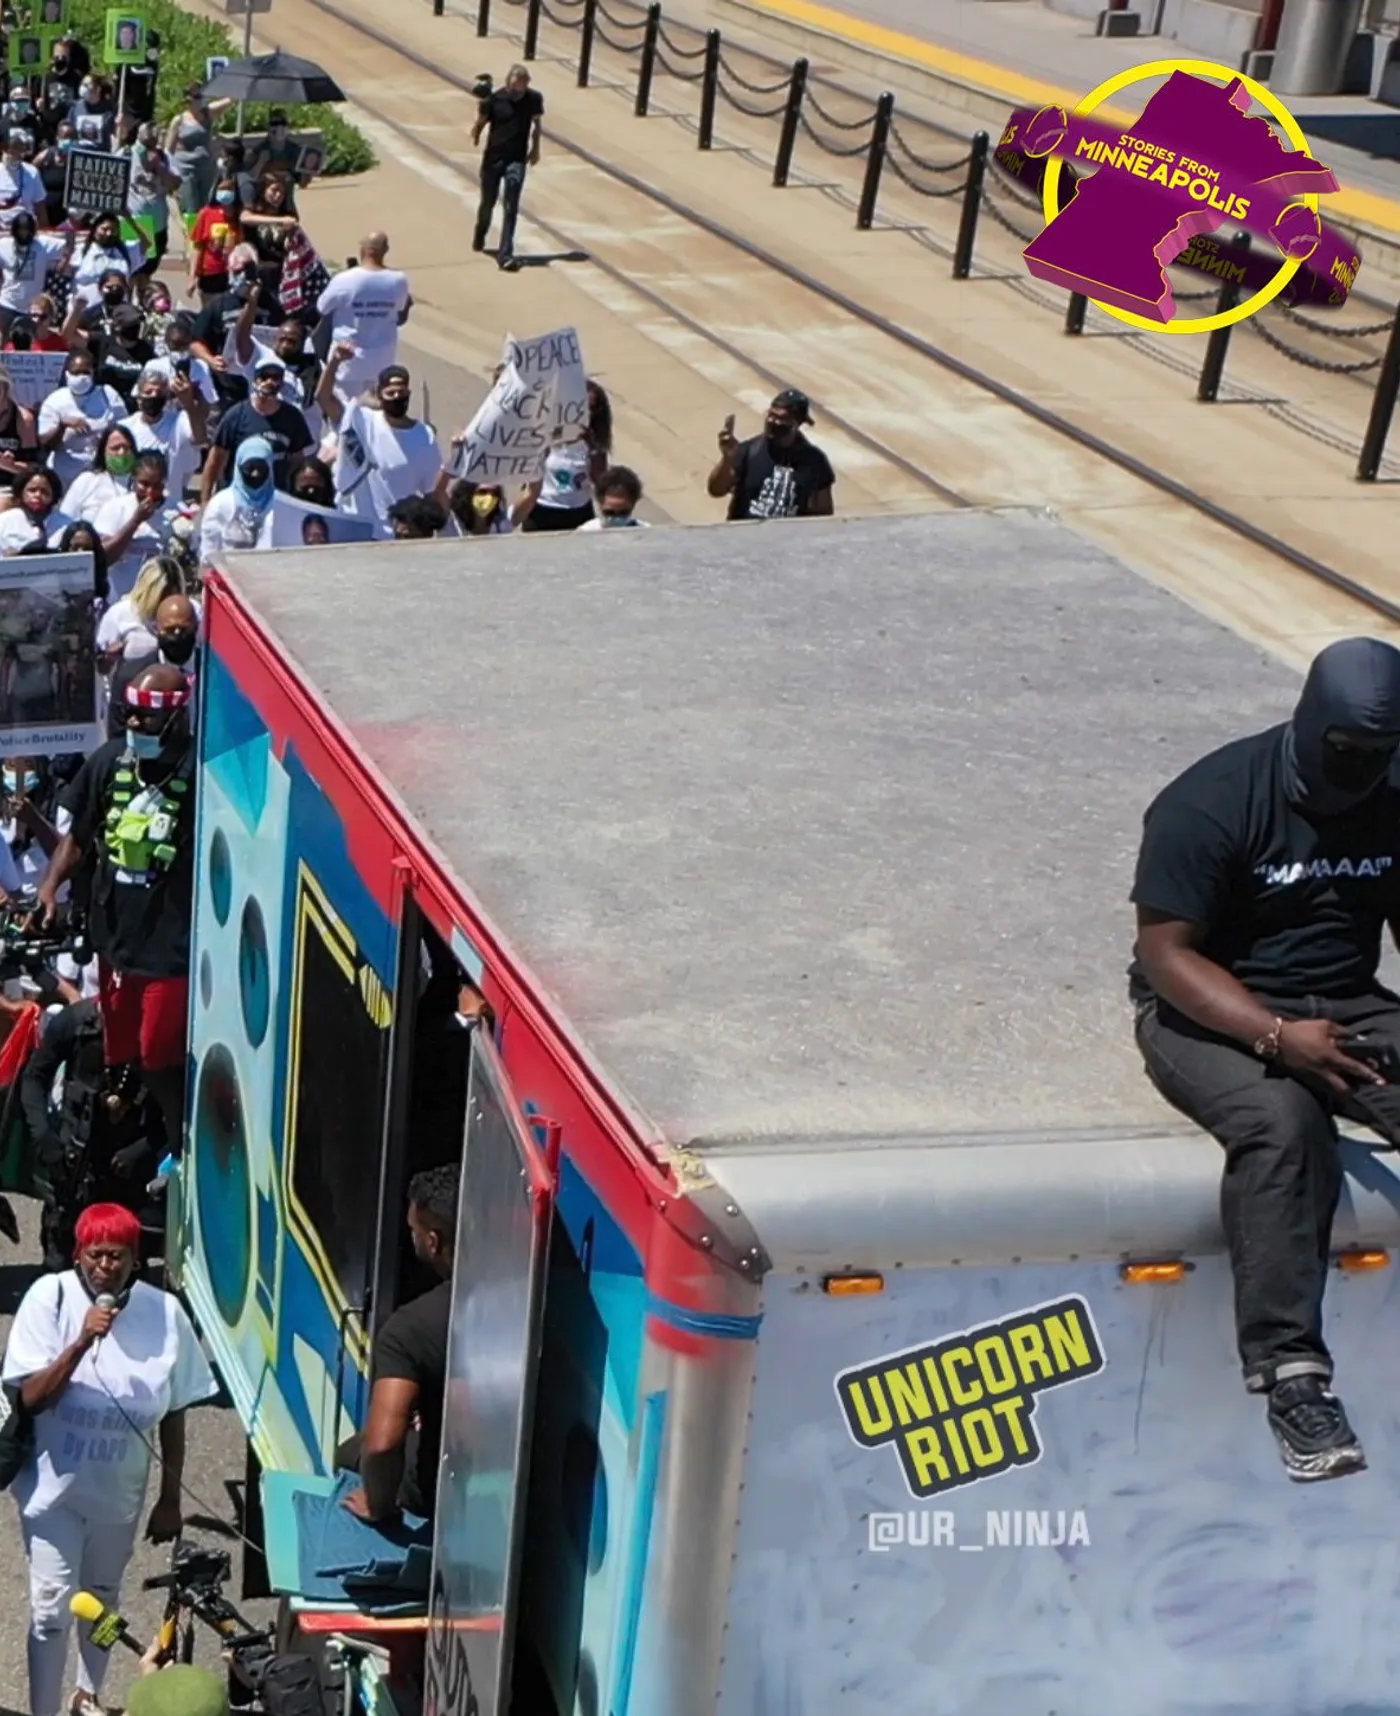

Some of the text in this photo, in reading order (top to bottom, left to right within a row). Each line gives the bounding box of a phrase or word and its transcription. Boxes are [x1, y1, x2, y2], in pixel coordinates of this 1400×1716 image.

[74, 155, 126, 176] NATIVE
[70, 189, 122, 211] MATTER
[525, 333, 581, 373] PEACE
[476, 421, 545, 448] LIVES
